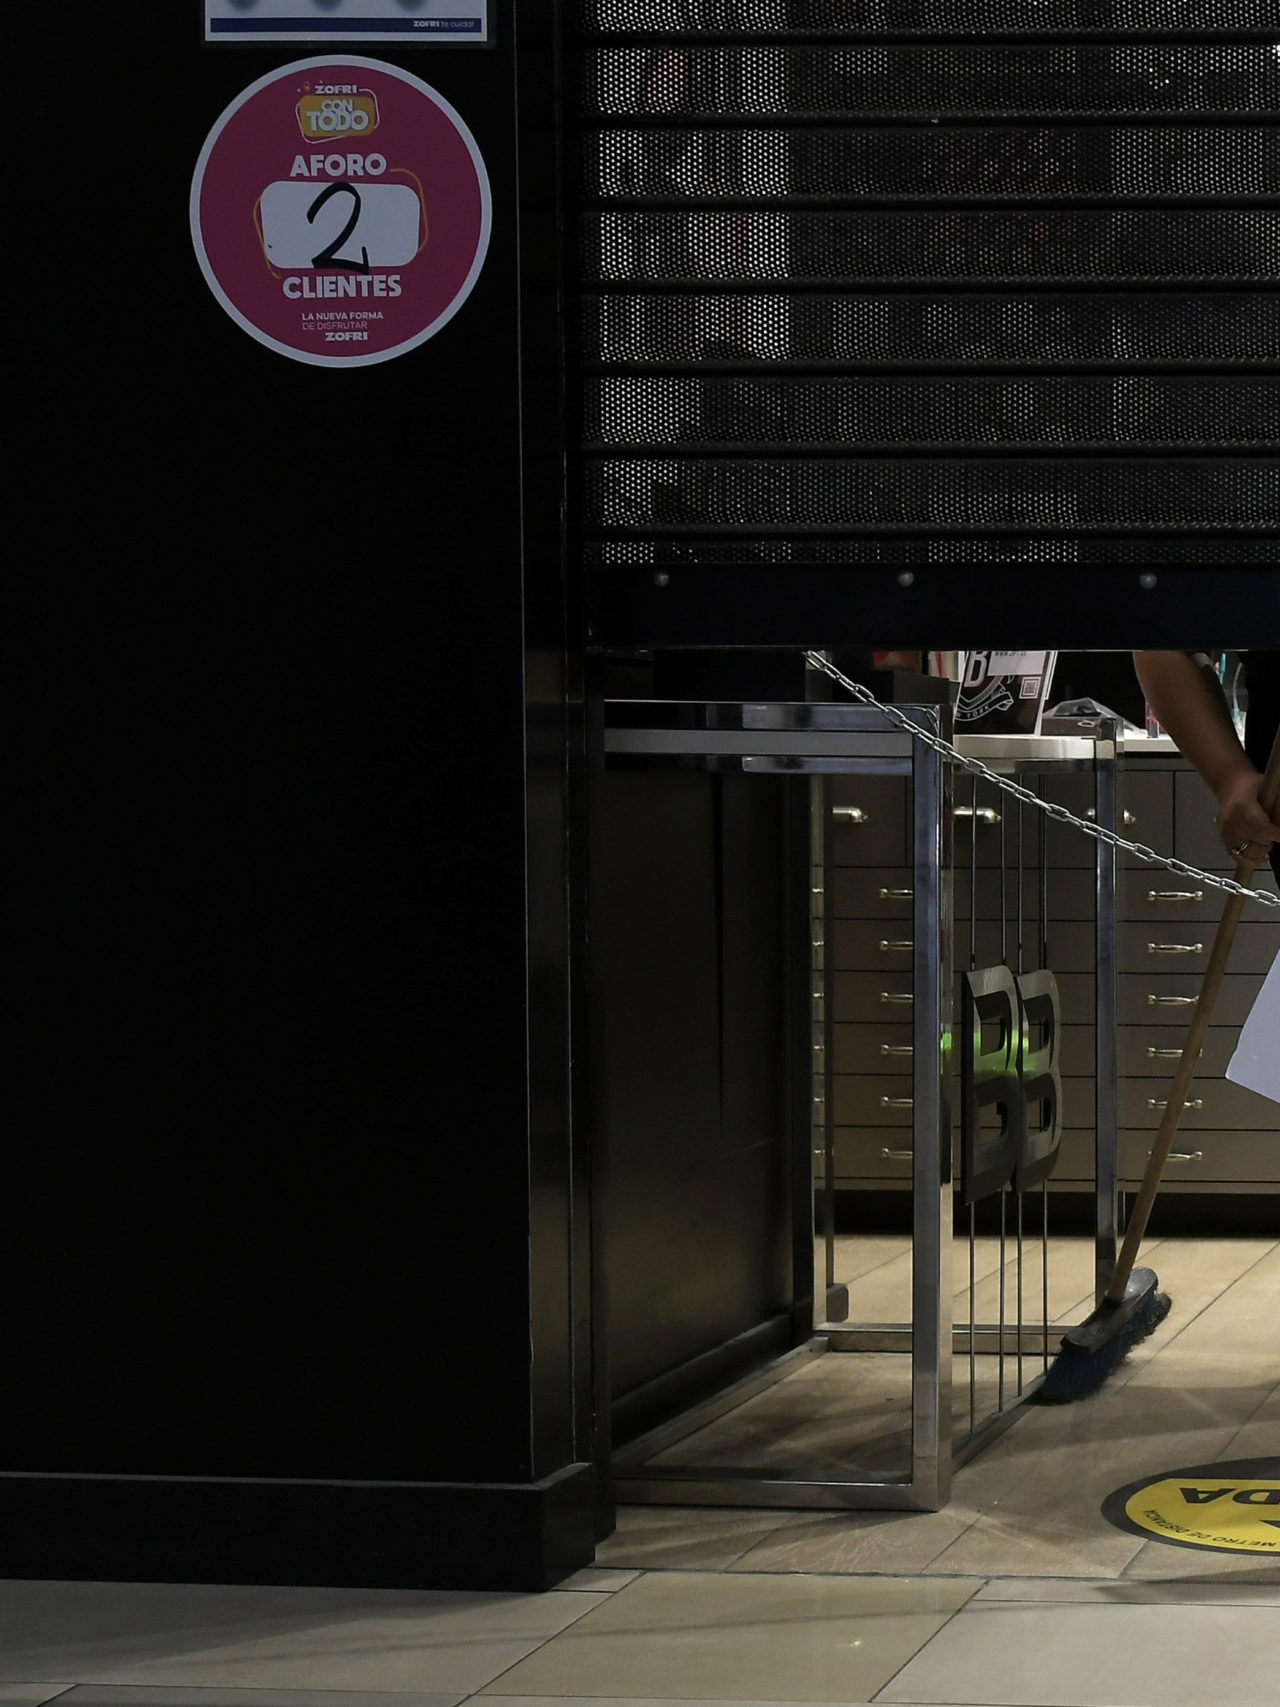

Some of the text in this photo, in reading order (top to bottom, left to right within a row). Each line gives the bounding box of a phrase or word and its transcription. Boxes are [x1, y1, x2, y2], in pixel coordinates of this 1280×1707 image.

[412, 20, 440, 28] ZOFRI
[314, 84, 358, 95] ZOFRI
[321, 99, 354, 112] CON
[305, 110, 370, 132] TODO
[290, 153, 388, 177] AFORO
[306, 181, 371, 275] 2
[282, 274, 402, 299] CLIENTES
[301, 311, 384, 321] LA NUEVA FORMA
[302, 321, 368, 331] DE DISFRUTAR
[324, 331, 369, 342] ZOFRI
[1188, 1531, 1212, 1540] DE
[1212, 1536, 1277, 1548] METRO
